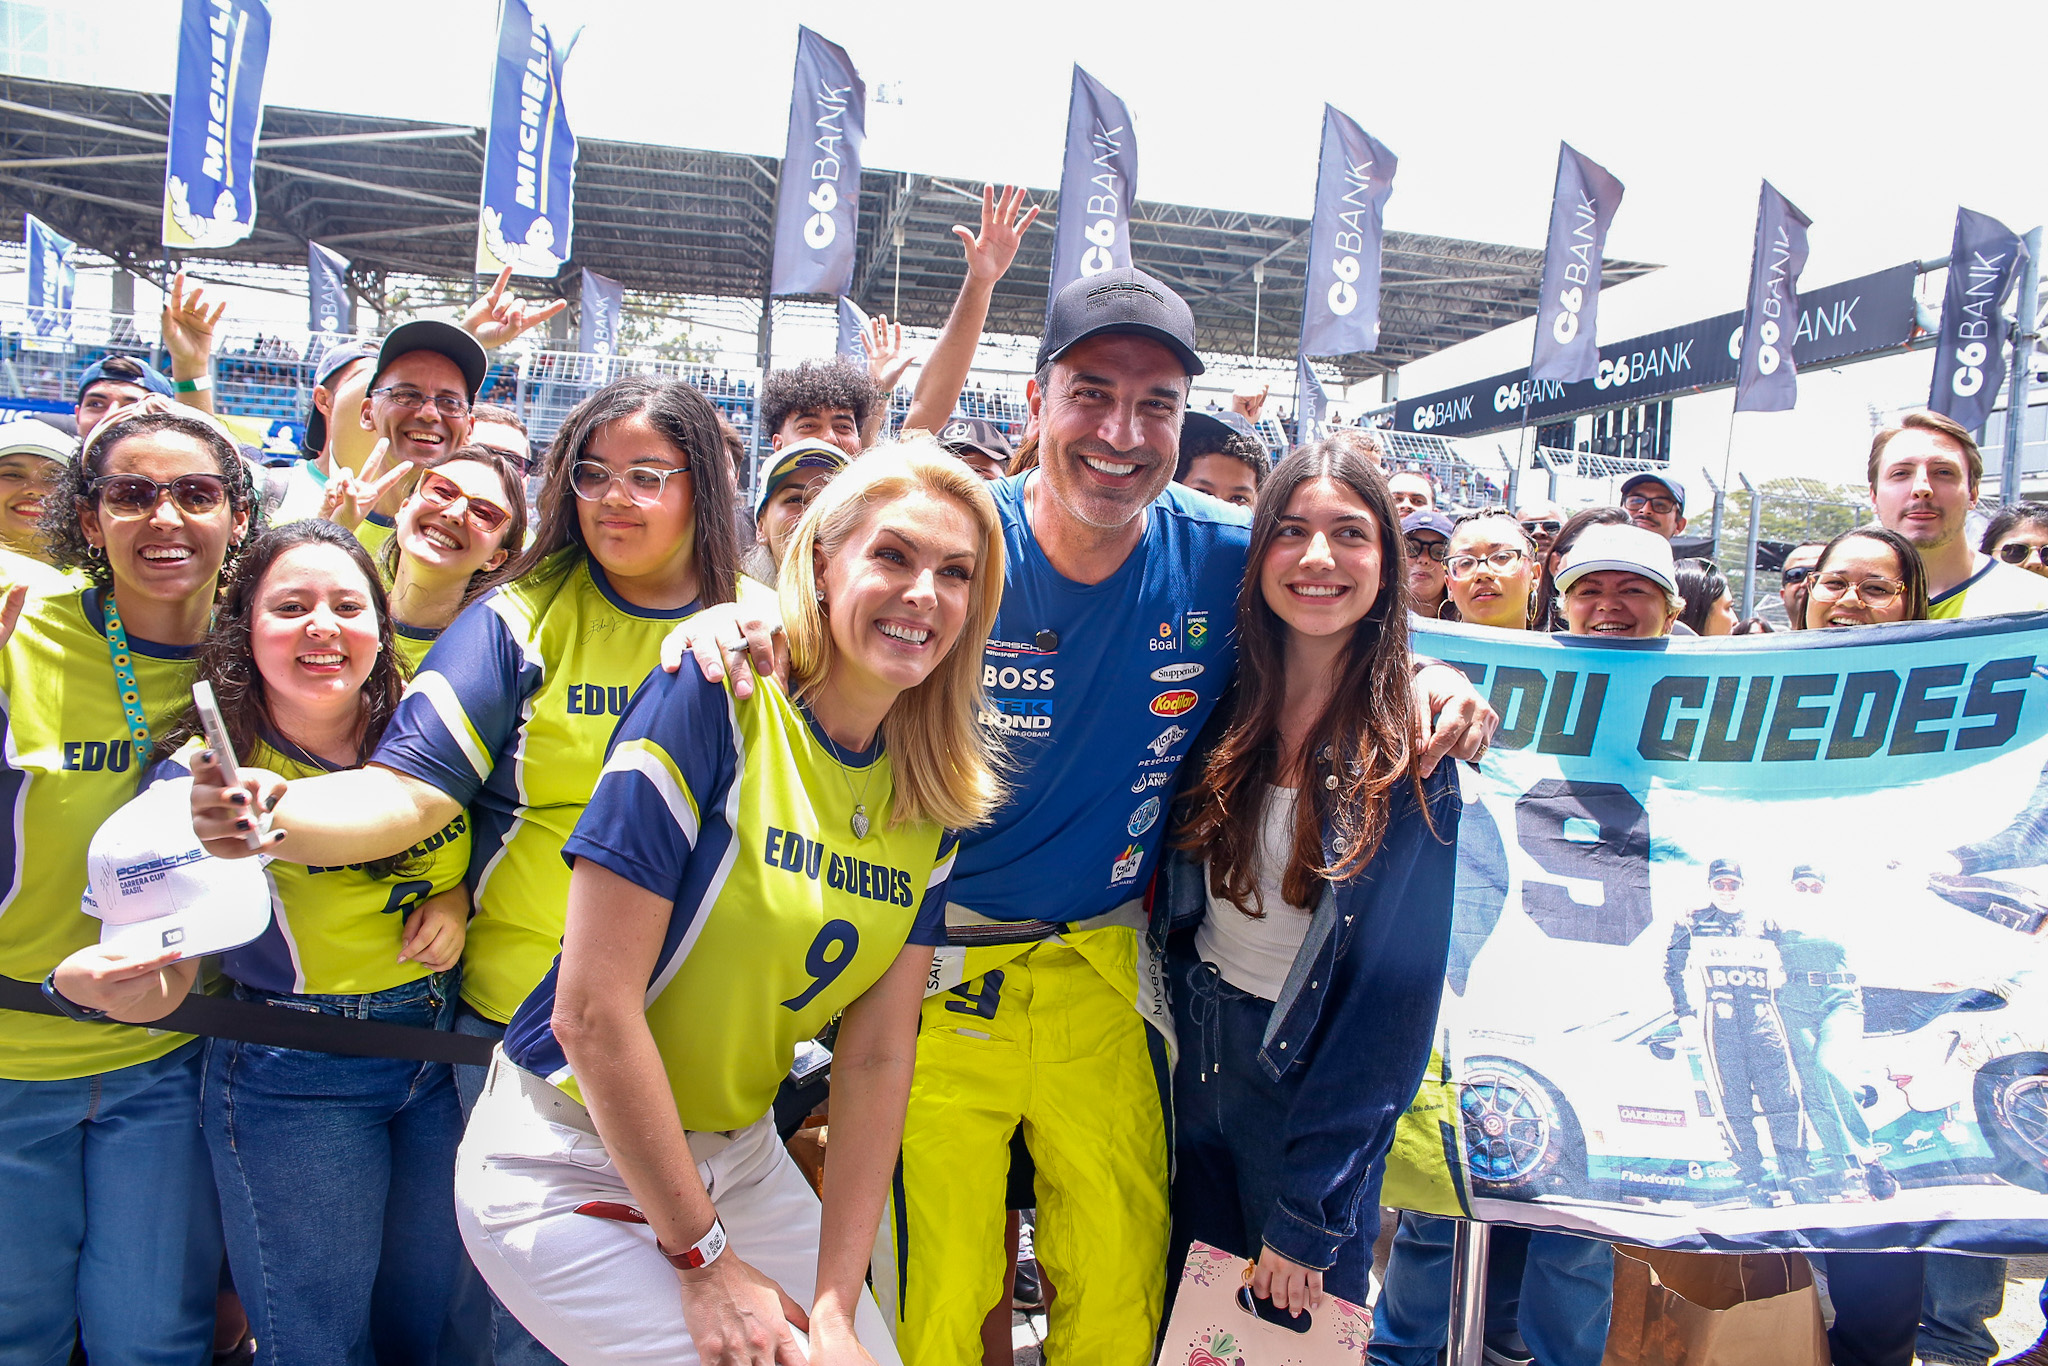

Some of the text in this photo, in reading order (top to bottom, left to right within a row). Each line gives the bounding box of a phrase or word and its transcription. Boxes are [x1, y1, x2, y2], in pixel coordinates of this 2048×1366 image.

[986, 638, 1047, 653] PORSCH
[1149, 636, 1177, 652] Boal
[982, 664, 1055, 691] BOSS
[566, 682, 630, 717] EDU
[1154, 693, 1196, 712] Kodilar
[1636, 655, 2038, 763] GUEDES
[977, 710, 1052, 730] BOND
[61, 739, 132, 773] EDU
[116, 849, 202, 878] PORSCHE
[764, 826, 914, 908] EDU GUEDES
[1514, 777, 1654, 948] 9
[119, 872, 166, 890] CARRERA CUP
[121, 886, 144, 897] BRASIL
[778, 918, 860, 1013] 9
[1712, 969, 1768, 989] BOSS
